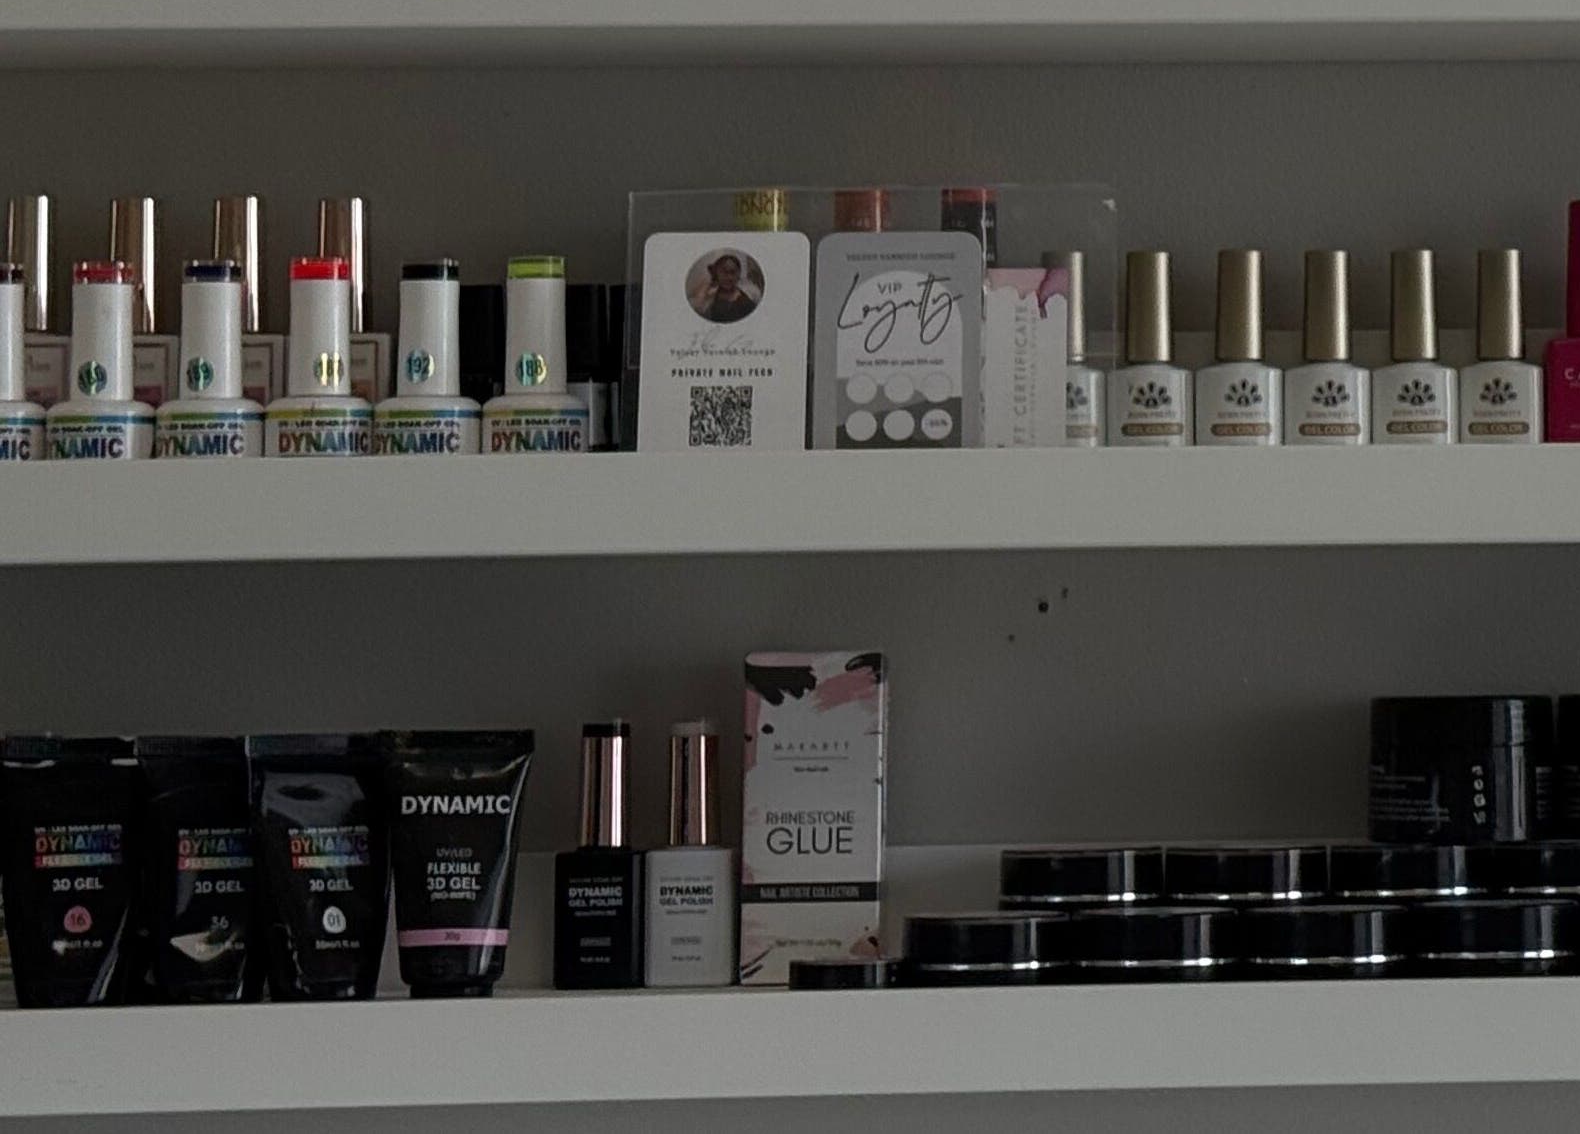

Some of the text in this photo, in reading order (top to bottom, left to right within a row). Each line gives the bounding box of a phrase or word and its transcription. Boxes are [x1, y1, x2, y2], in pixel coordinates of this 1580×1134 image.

[878, 281, 903, 294] VIP
[836, 271, 964, 354] Loyalty
[671, 368, 713, 378] PRIVATE
[719, 368, 743, 378] NAIL
[279, 432, 370, 453] DYNAMIC
[491, 431, 581, 452] DYNAMIC
[401, 793, 512, 816] DYNAMIC
[766, 810, 855, 825] RHINESTONE
[36, 833, 120, 853] DYNAMIC
[291, 834, 369, 854] DYNAMIC
[766, 827, 853, 855] GLUE
[427, 861, 482, 875] FLEXIBLE
[74, 877, 105, 891] GEL
[215, 879, 245, 893] GEL
[327, 878, 354, 892] GEL
[426, 876, 482, 891] 3D GEL
[569, 887, 623, 897] DYNAMIC
[660, 886, 714, 896] DYNAMIC
[569, 897, 588, 907] GEL
[660, 897, 678, 906] GEL
